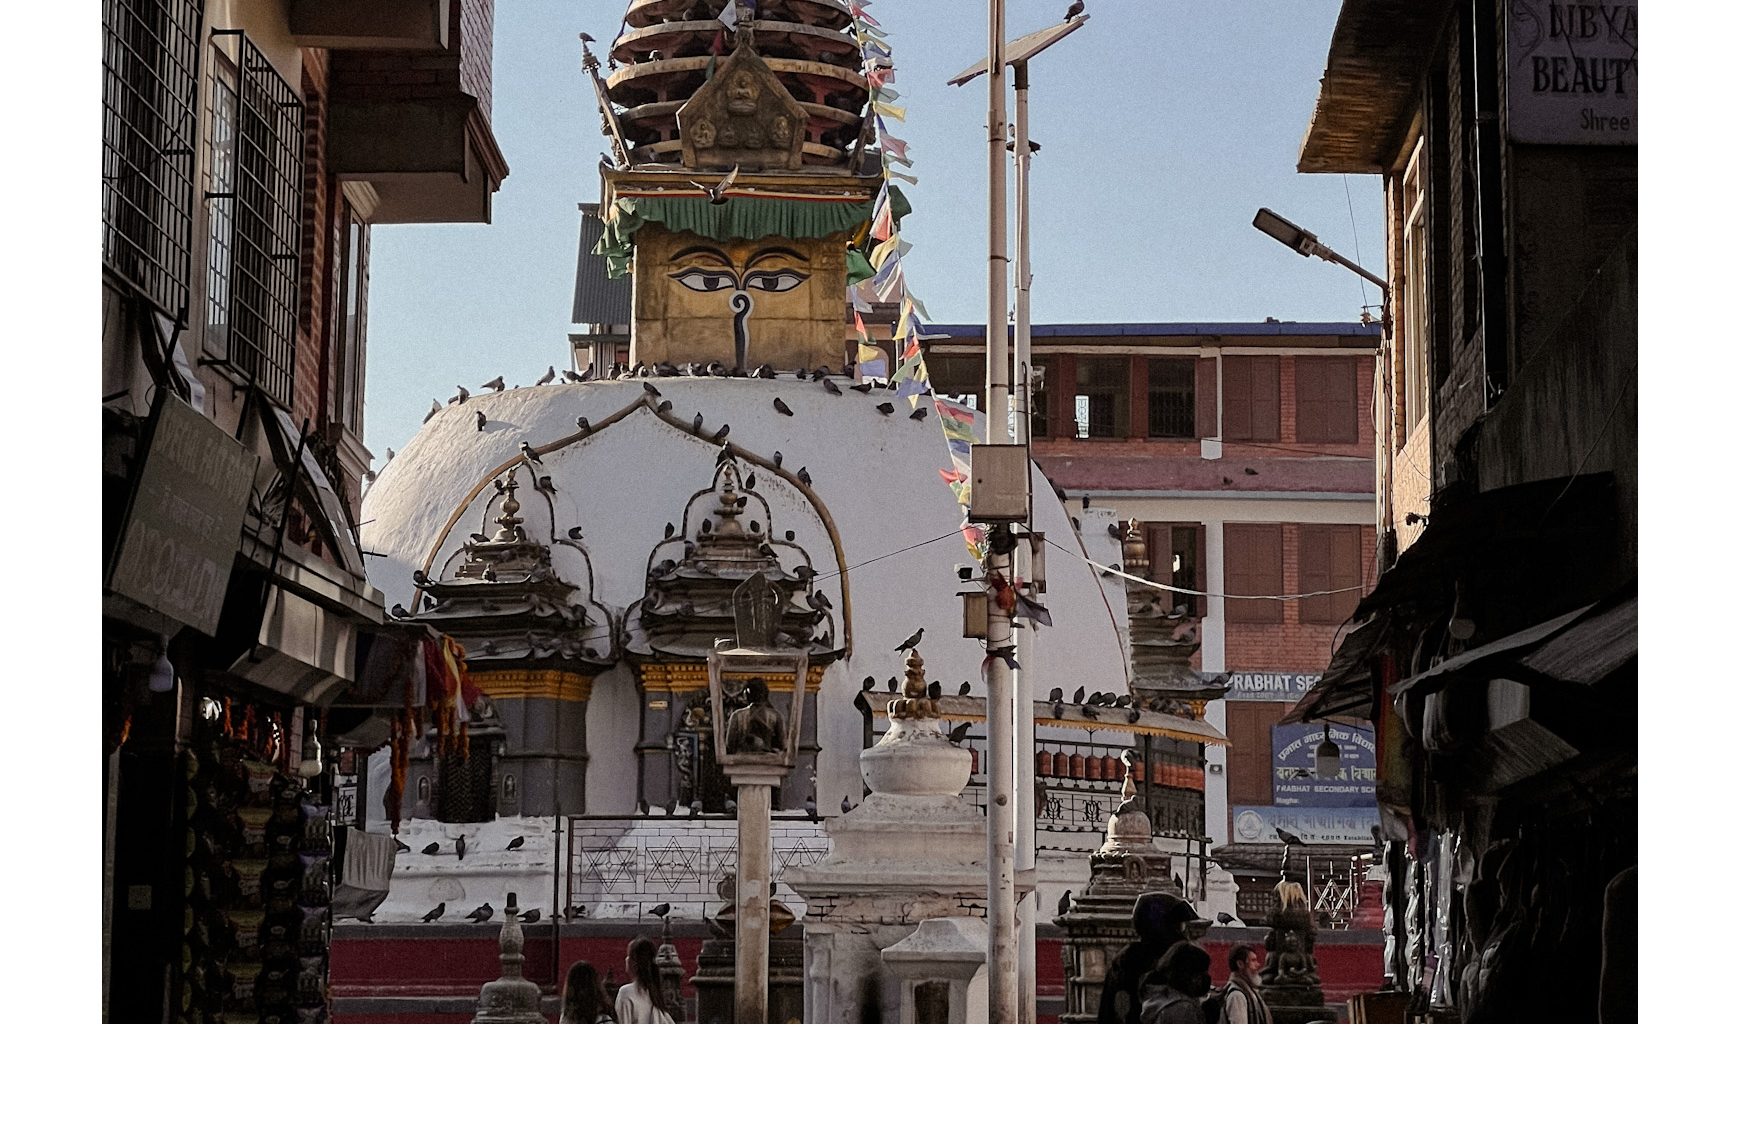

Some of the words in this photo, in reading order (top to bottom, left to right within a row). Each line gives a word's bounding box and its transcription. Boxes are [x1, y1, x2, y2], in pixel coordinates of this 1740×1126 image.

[1532, 56, 1638, 94] BEAUT
[1580, 108, 1630, 131] Shree
[1276, 785, 1311, 793] PRABHAT
[1314, 785, 1359, 793] SECONDARY
